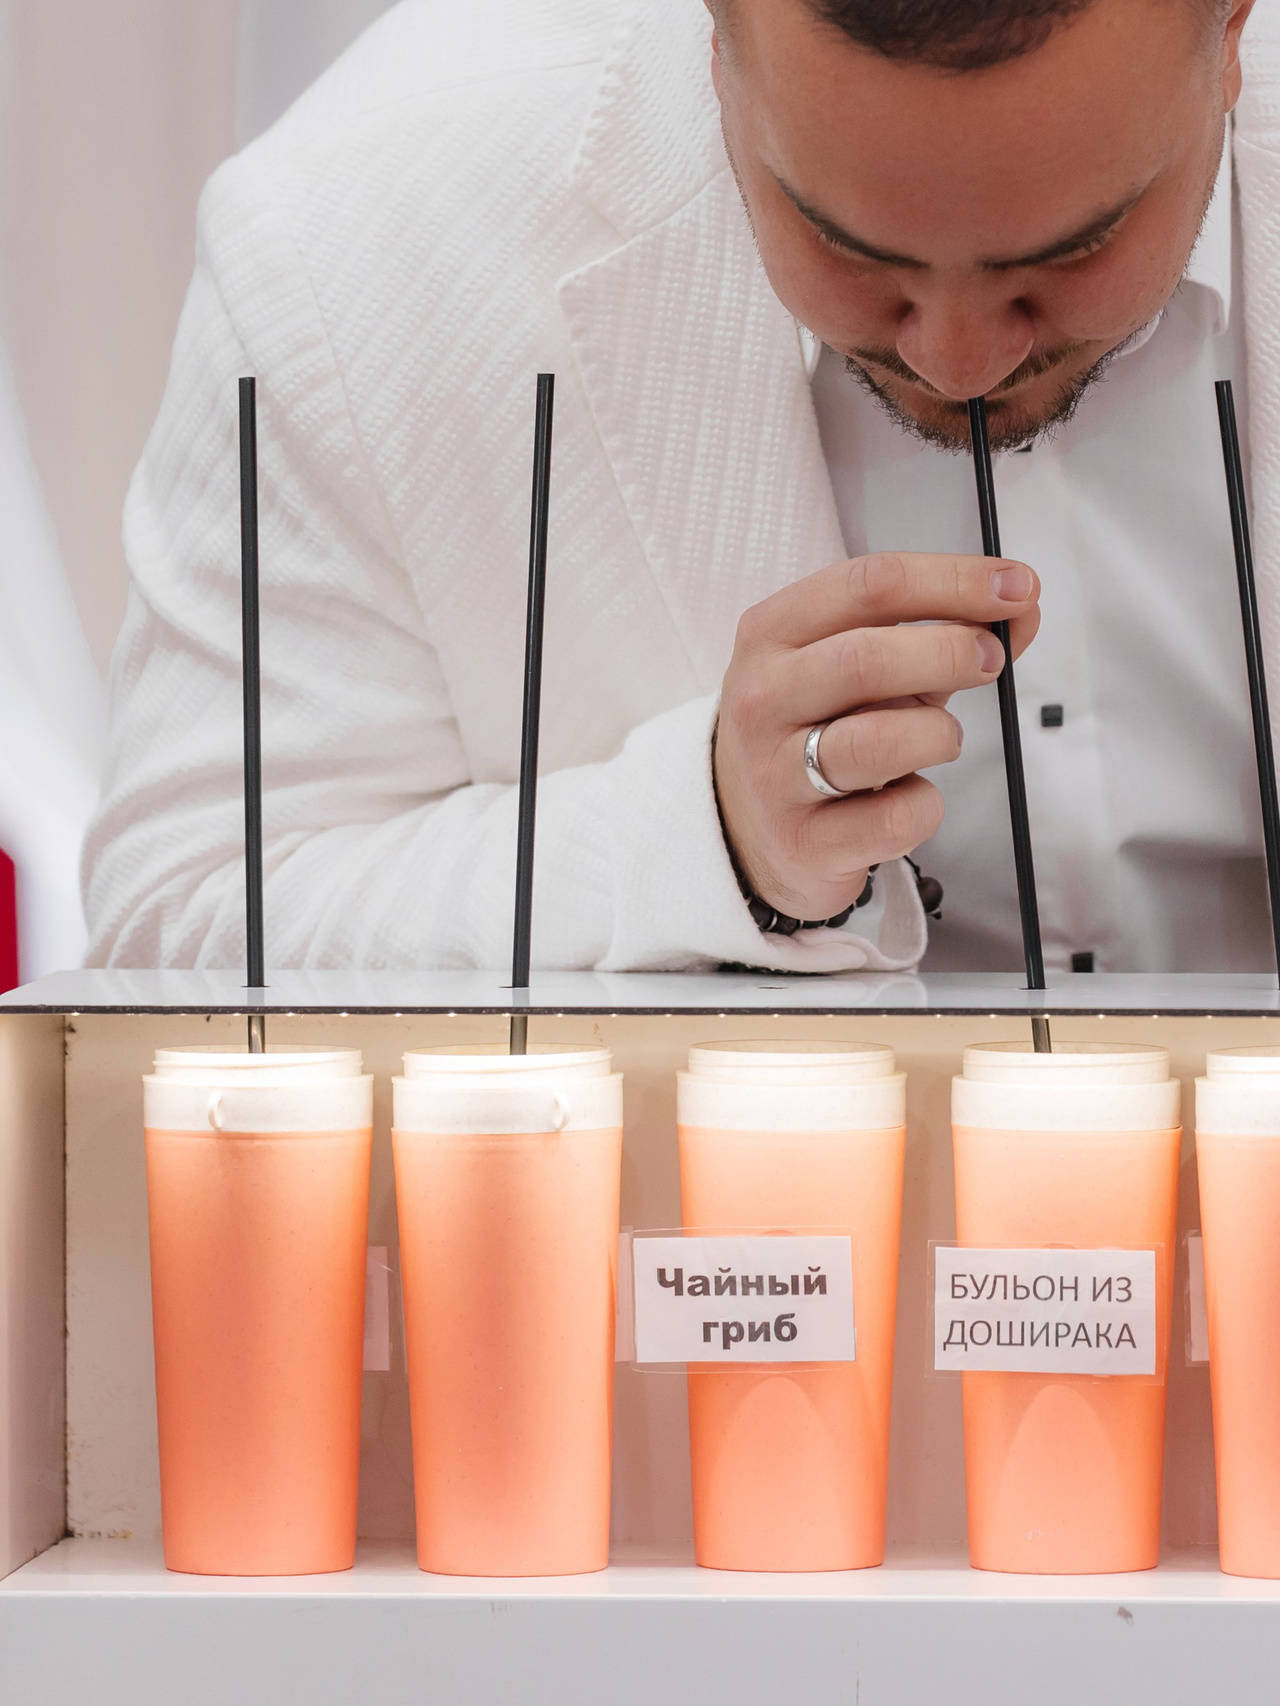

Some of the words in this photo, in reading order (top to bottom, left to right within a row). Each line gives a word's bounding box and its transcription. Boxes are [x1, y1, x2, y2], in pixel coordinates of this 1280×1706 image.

[656, 1265, 828, 1297] Чайный
[951, 1273, 1079, 1302] БУЛЬОН
[1092, 1276, 1133, 1303] ИЗ
[702, 1312, 798, 1350] гриб
[942, 1319, 1137, 1352] ДОШИРАКА
